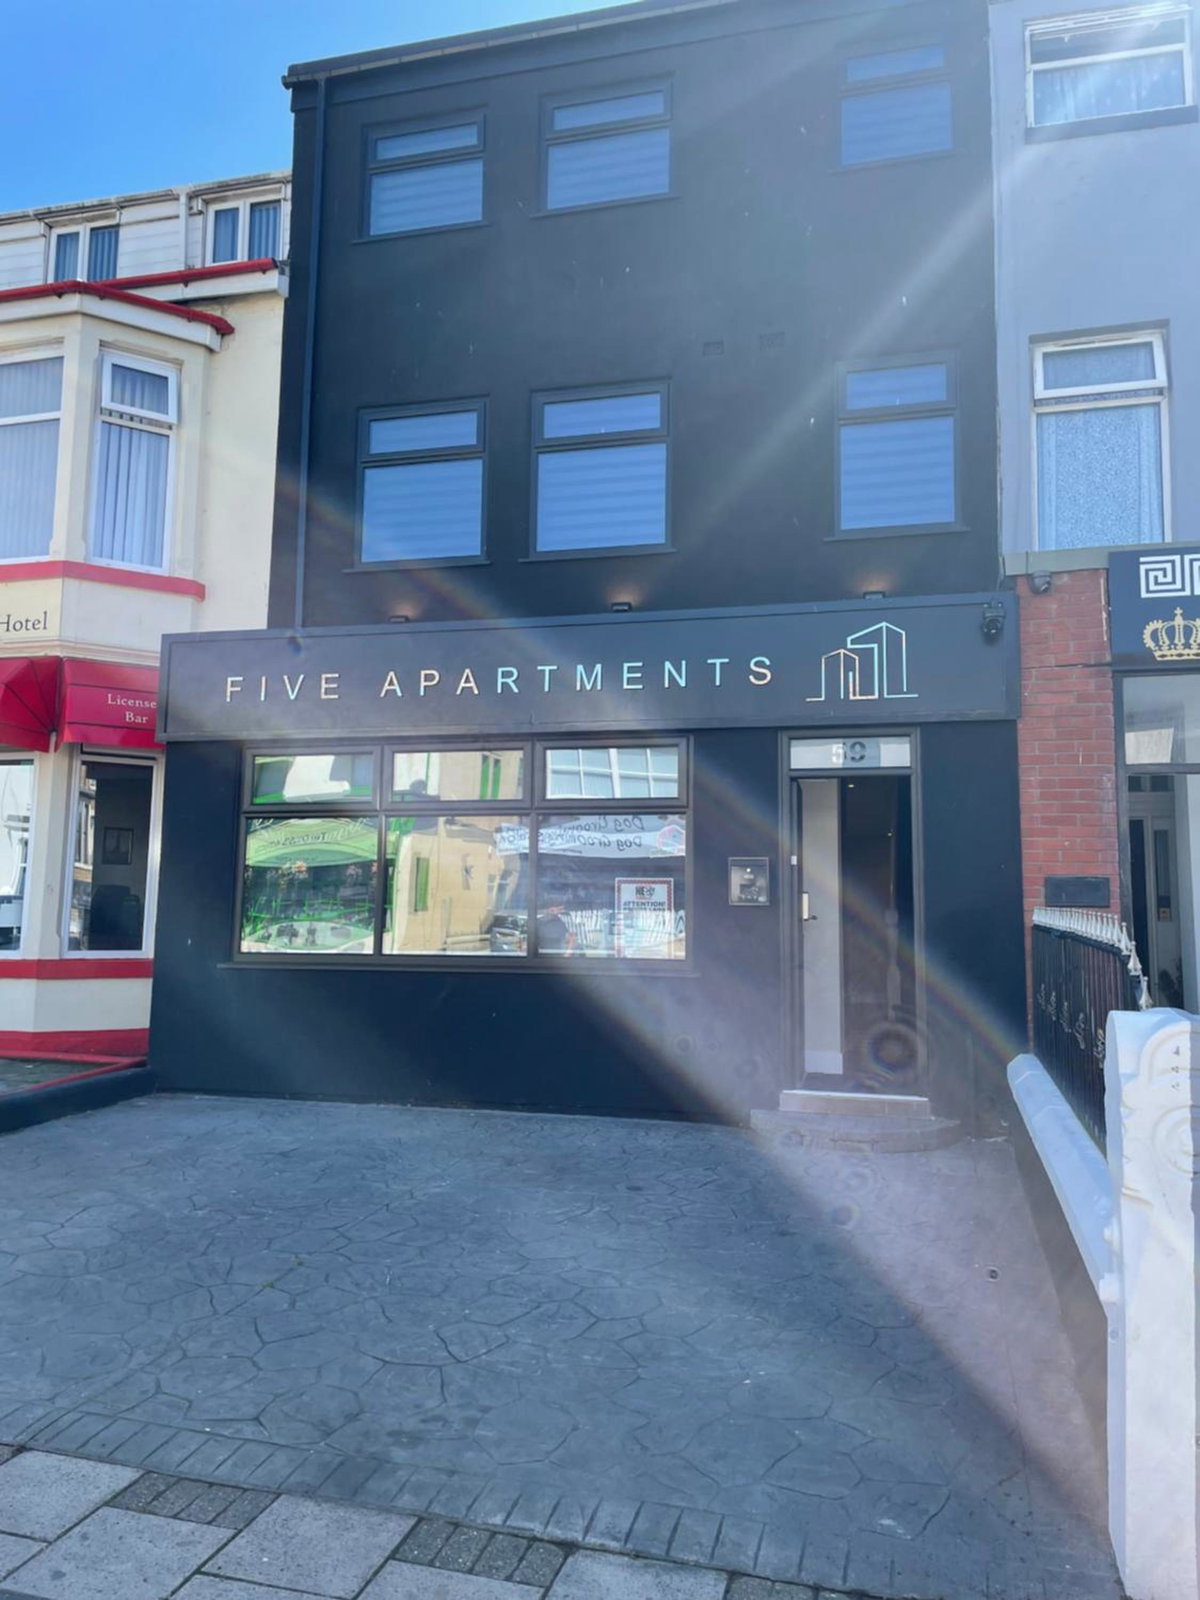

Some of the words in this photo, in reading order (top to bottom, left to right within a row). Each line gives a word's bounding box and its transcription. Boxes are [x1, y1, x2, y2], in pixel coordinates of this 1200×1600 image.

[0, 610, 48, 633] Hotel
[225, 672, 340, 703] FIVE
[379, 656, 772, 698] APARTMENTS
[125, 711, 149, 724] Bar
